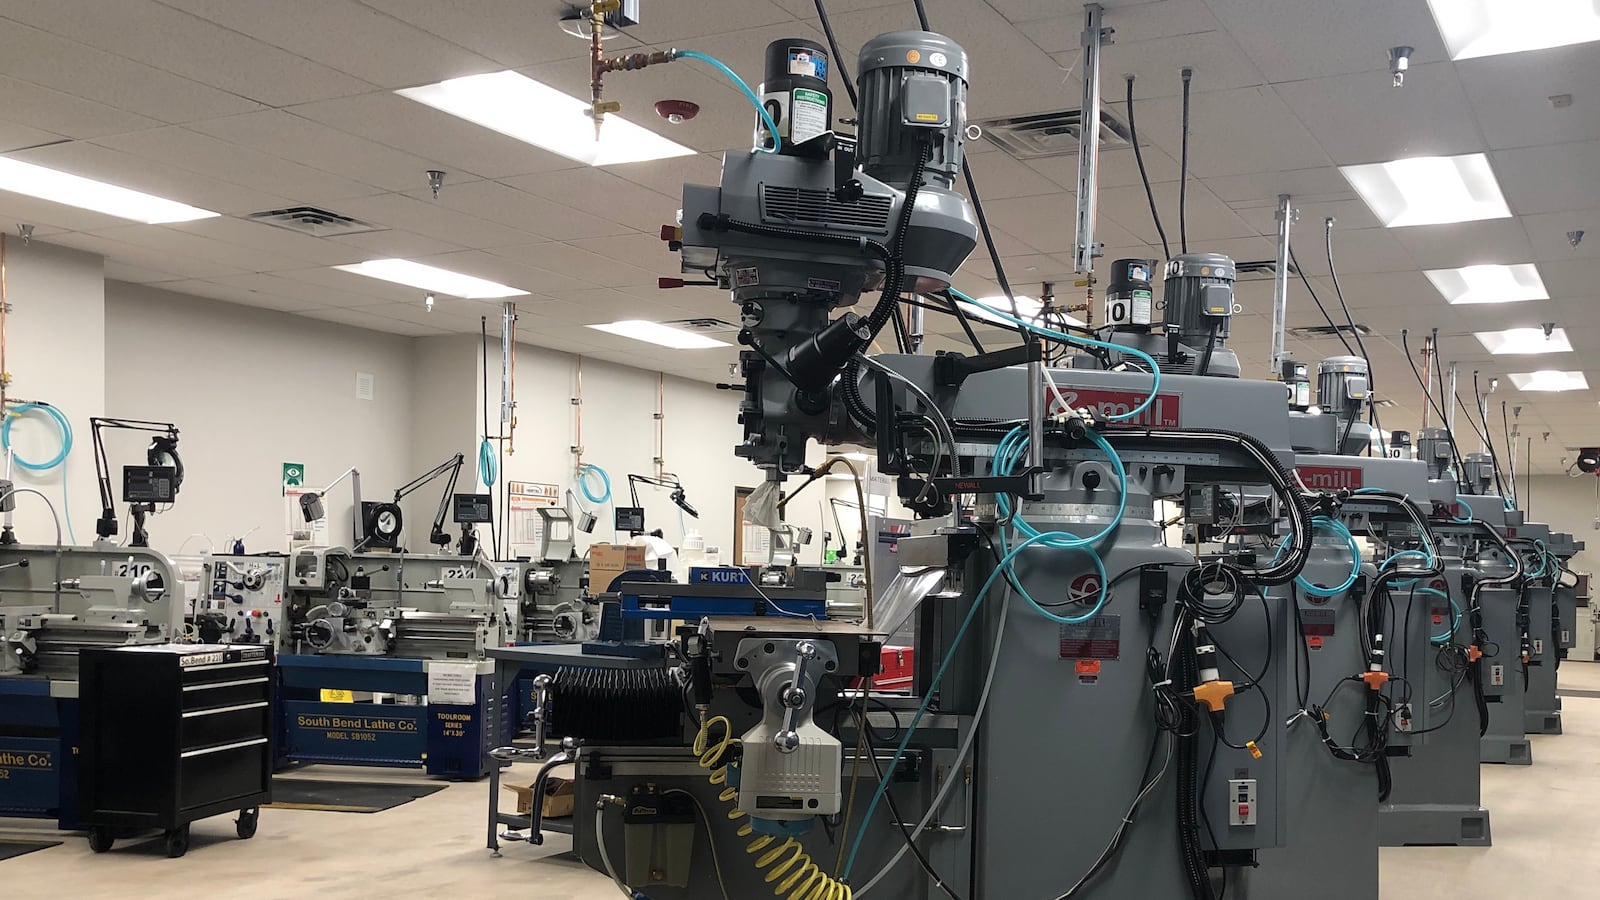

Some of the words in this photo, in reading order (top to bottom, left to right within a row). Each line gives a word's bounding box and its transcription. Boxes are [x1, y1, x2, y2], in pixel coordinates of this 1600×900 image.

[712, 571, 745, 582] KURT
[437, 712, 471, 721] TOOLROOM
[297, 716, 330, 727] South
[332, 717, 362, 728] Bend
[364, 718, 396, 730] Lathe
[326, 731, 349, 740] MODEL
